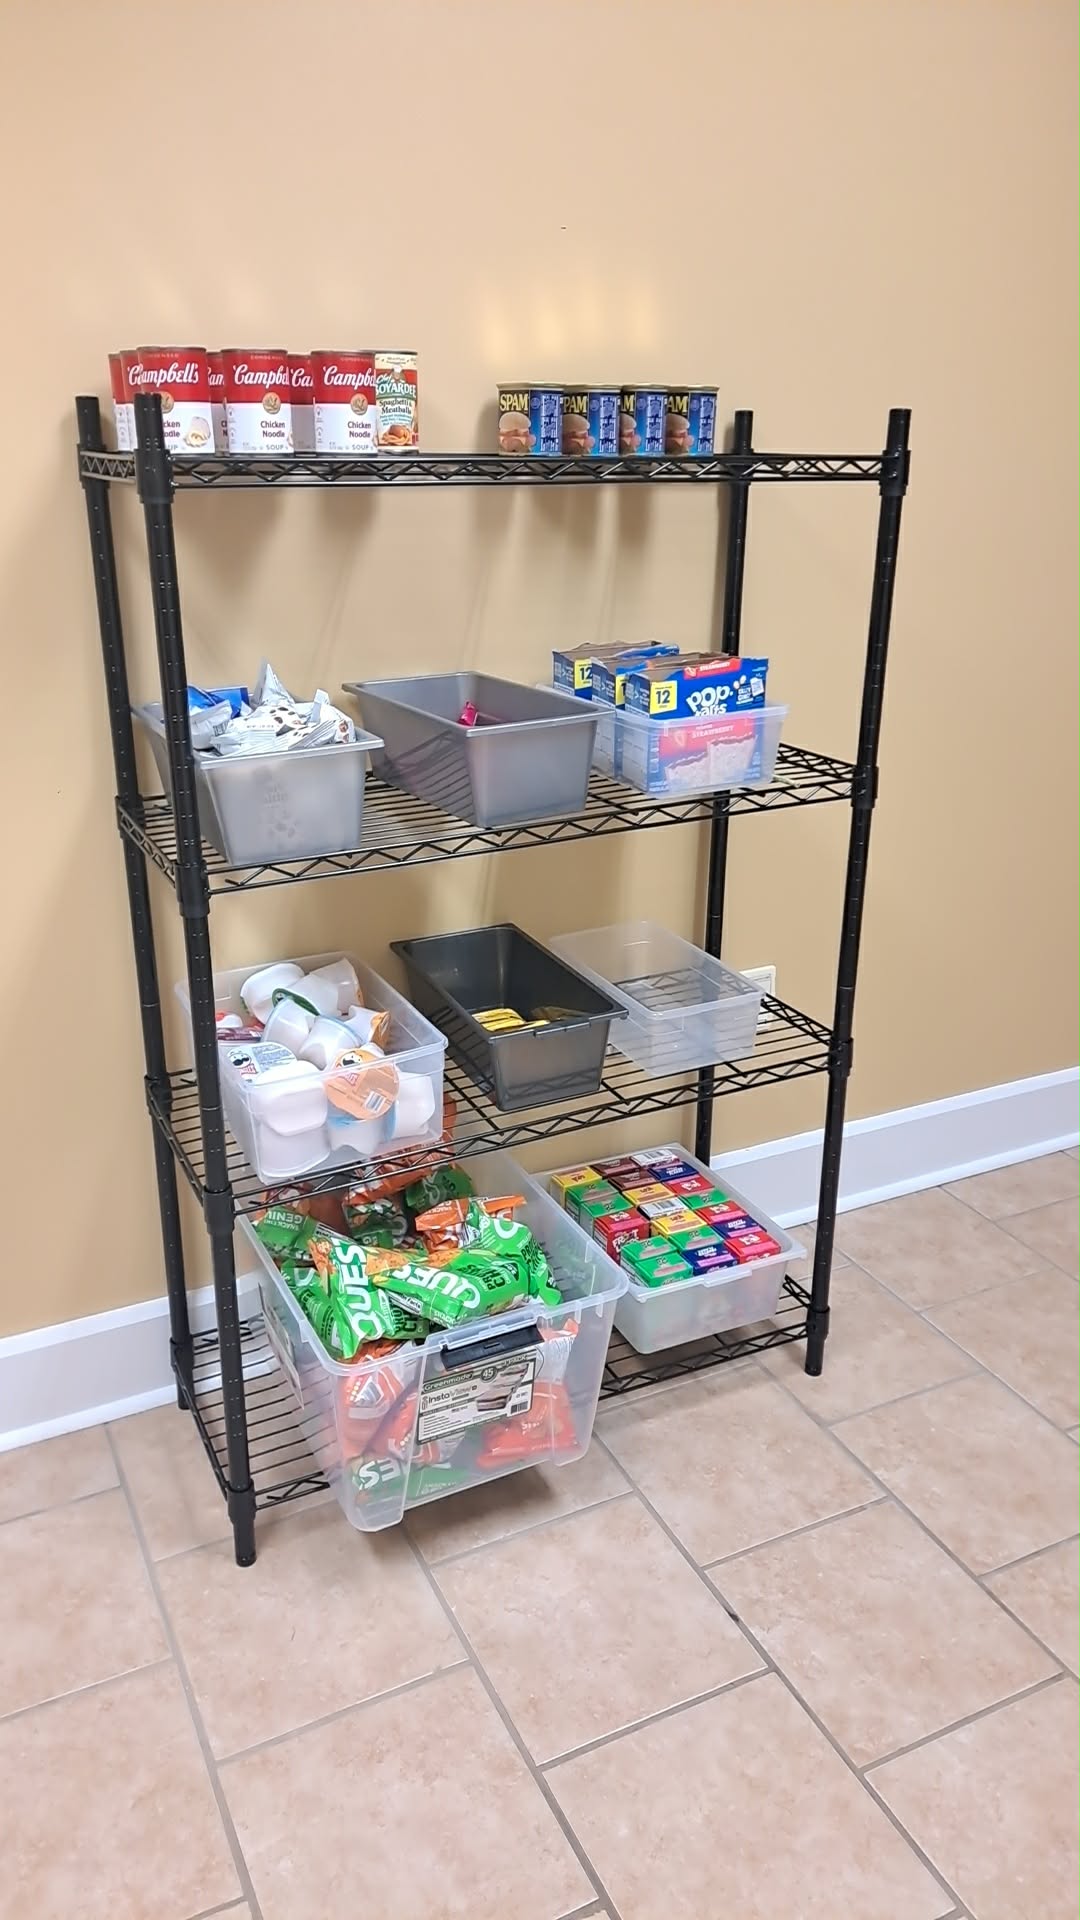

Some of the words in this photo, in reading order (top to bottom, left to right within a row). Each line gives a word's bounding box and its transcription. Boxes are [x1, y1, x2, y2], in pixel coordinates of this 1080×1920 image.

[500, 393, 529, 411] SPAM
[563, 395, 588, 413] PAM
[667, 395, 689, 413] AM
[163, 420, 181, 428] cken
[260, 421, 286, 429] Chicken
[347, 421, 372, 429] Chicken
[164, 429, 181, 438] odle
[262, 430, 285, 438] Noodle
[579, 667, 592, 681] 12
[655, 689, 671, 704] 12
[391, 1264, 481, 1309] QUES
[482, 1367, 495, 1378] 45
